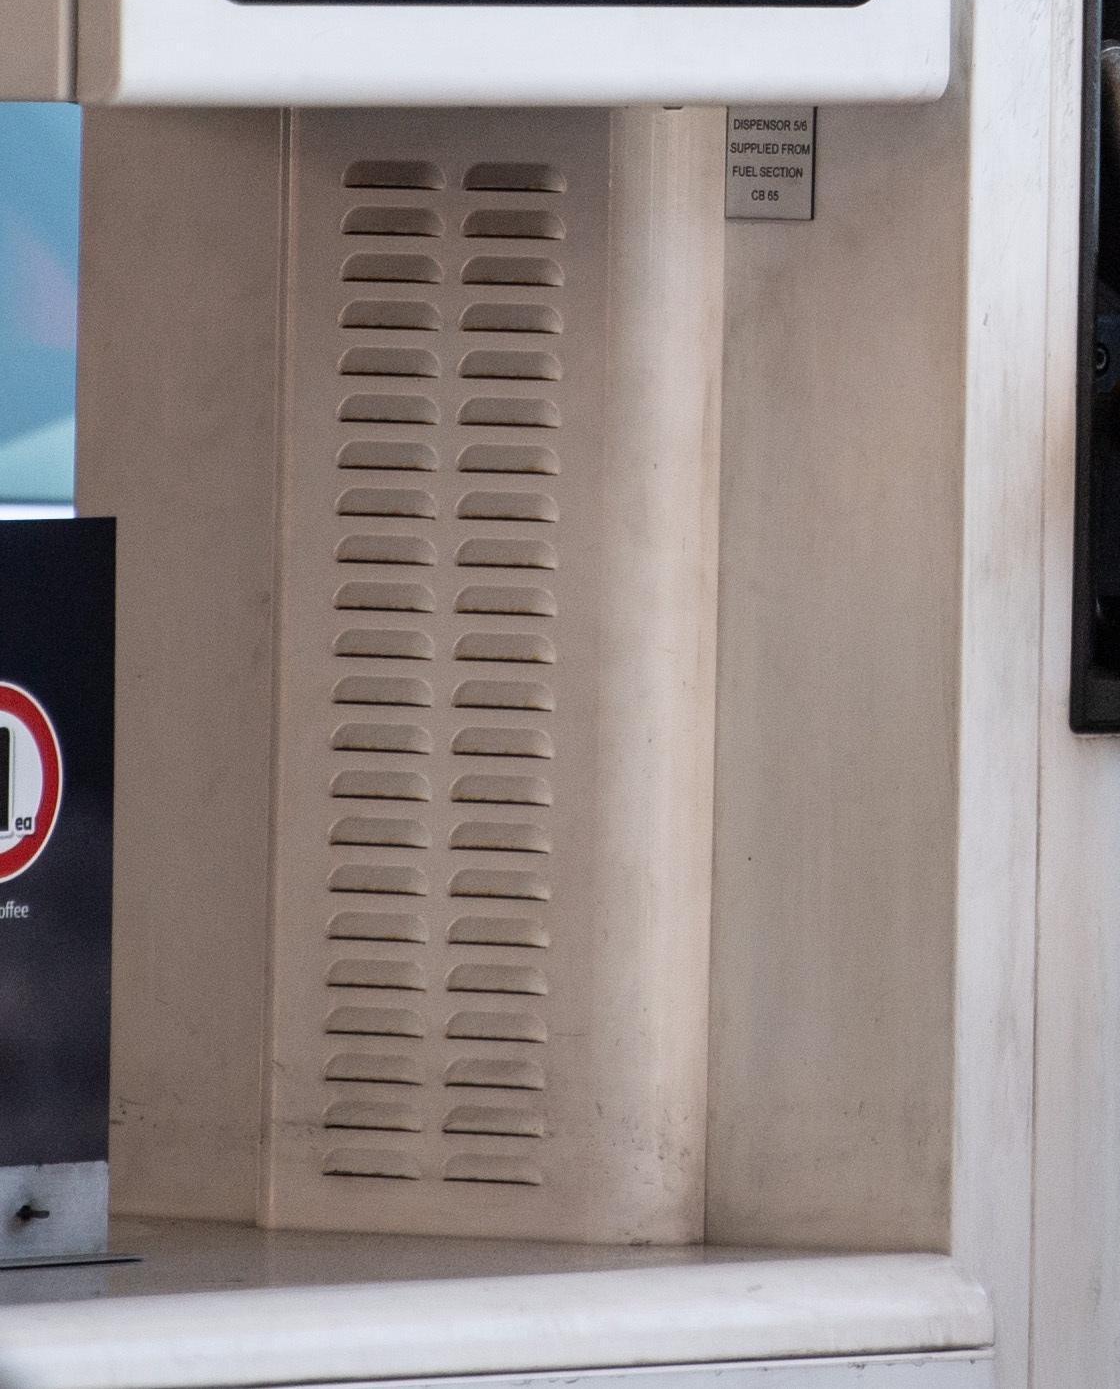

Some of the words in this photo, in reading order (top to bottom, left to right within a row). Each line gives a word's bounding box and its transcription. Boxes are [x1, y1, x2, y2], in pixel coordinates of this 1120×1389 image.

[733, 119, 791, 131] DISPENSOR
[793, 120, 808, 131] 5/6
[730, 143, 779, 155] SUPPLIED
[782, 144, 811, 156] FROM
[732, 166, 758, 178] FUEL
[760, 166, 803, 179] SECTION
[751, 190, 765, 201] CB
[15, 817, 32, 831] ea
